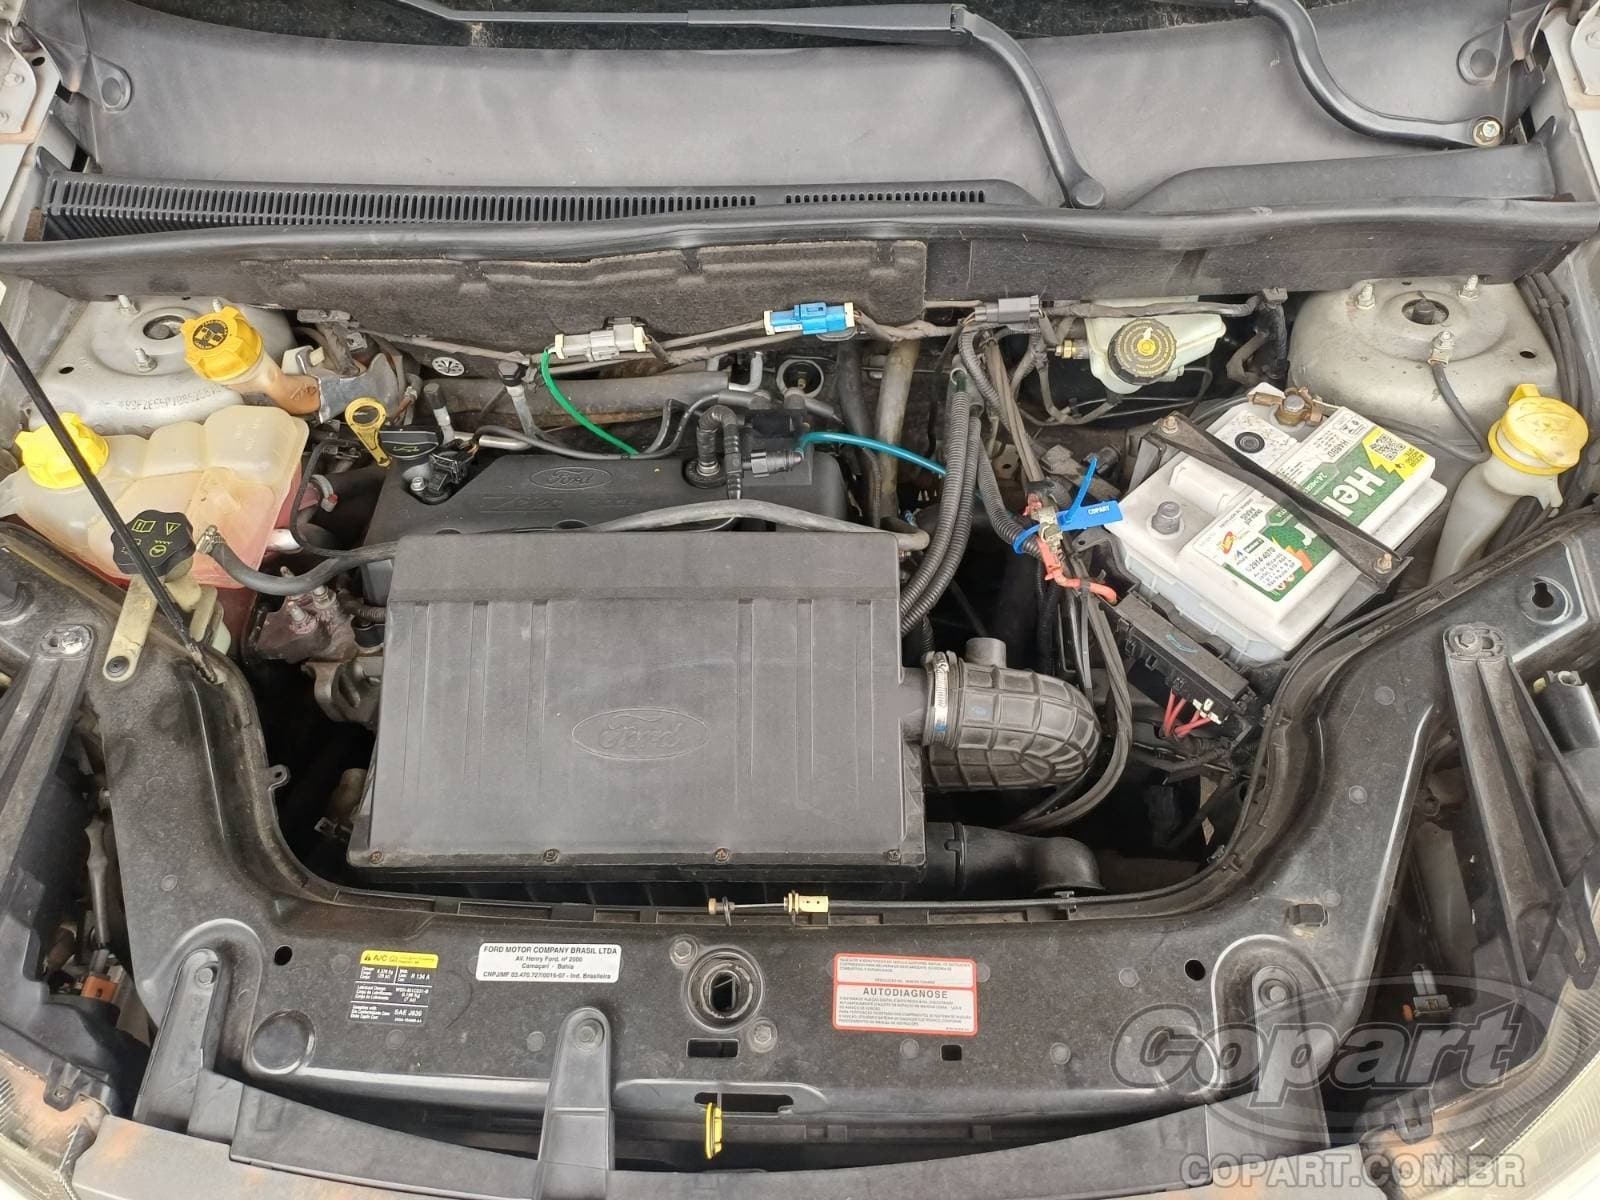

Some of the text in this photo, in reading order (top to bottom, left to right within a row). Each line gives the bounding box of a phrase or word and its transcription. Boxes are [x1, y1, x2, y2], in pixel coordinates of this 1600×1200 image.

[546, 469, 594, 486] Ford
[1087, 504, 1111, 515] COPART
[600, 713, 683, 749] Ford
[483, 945, 617, 955] FORD MOTOR COMPANY BRASIL LTDA
[863, 987, 949, 999] AUTODIAGNOSE
